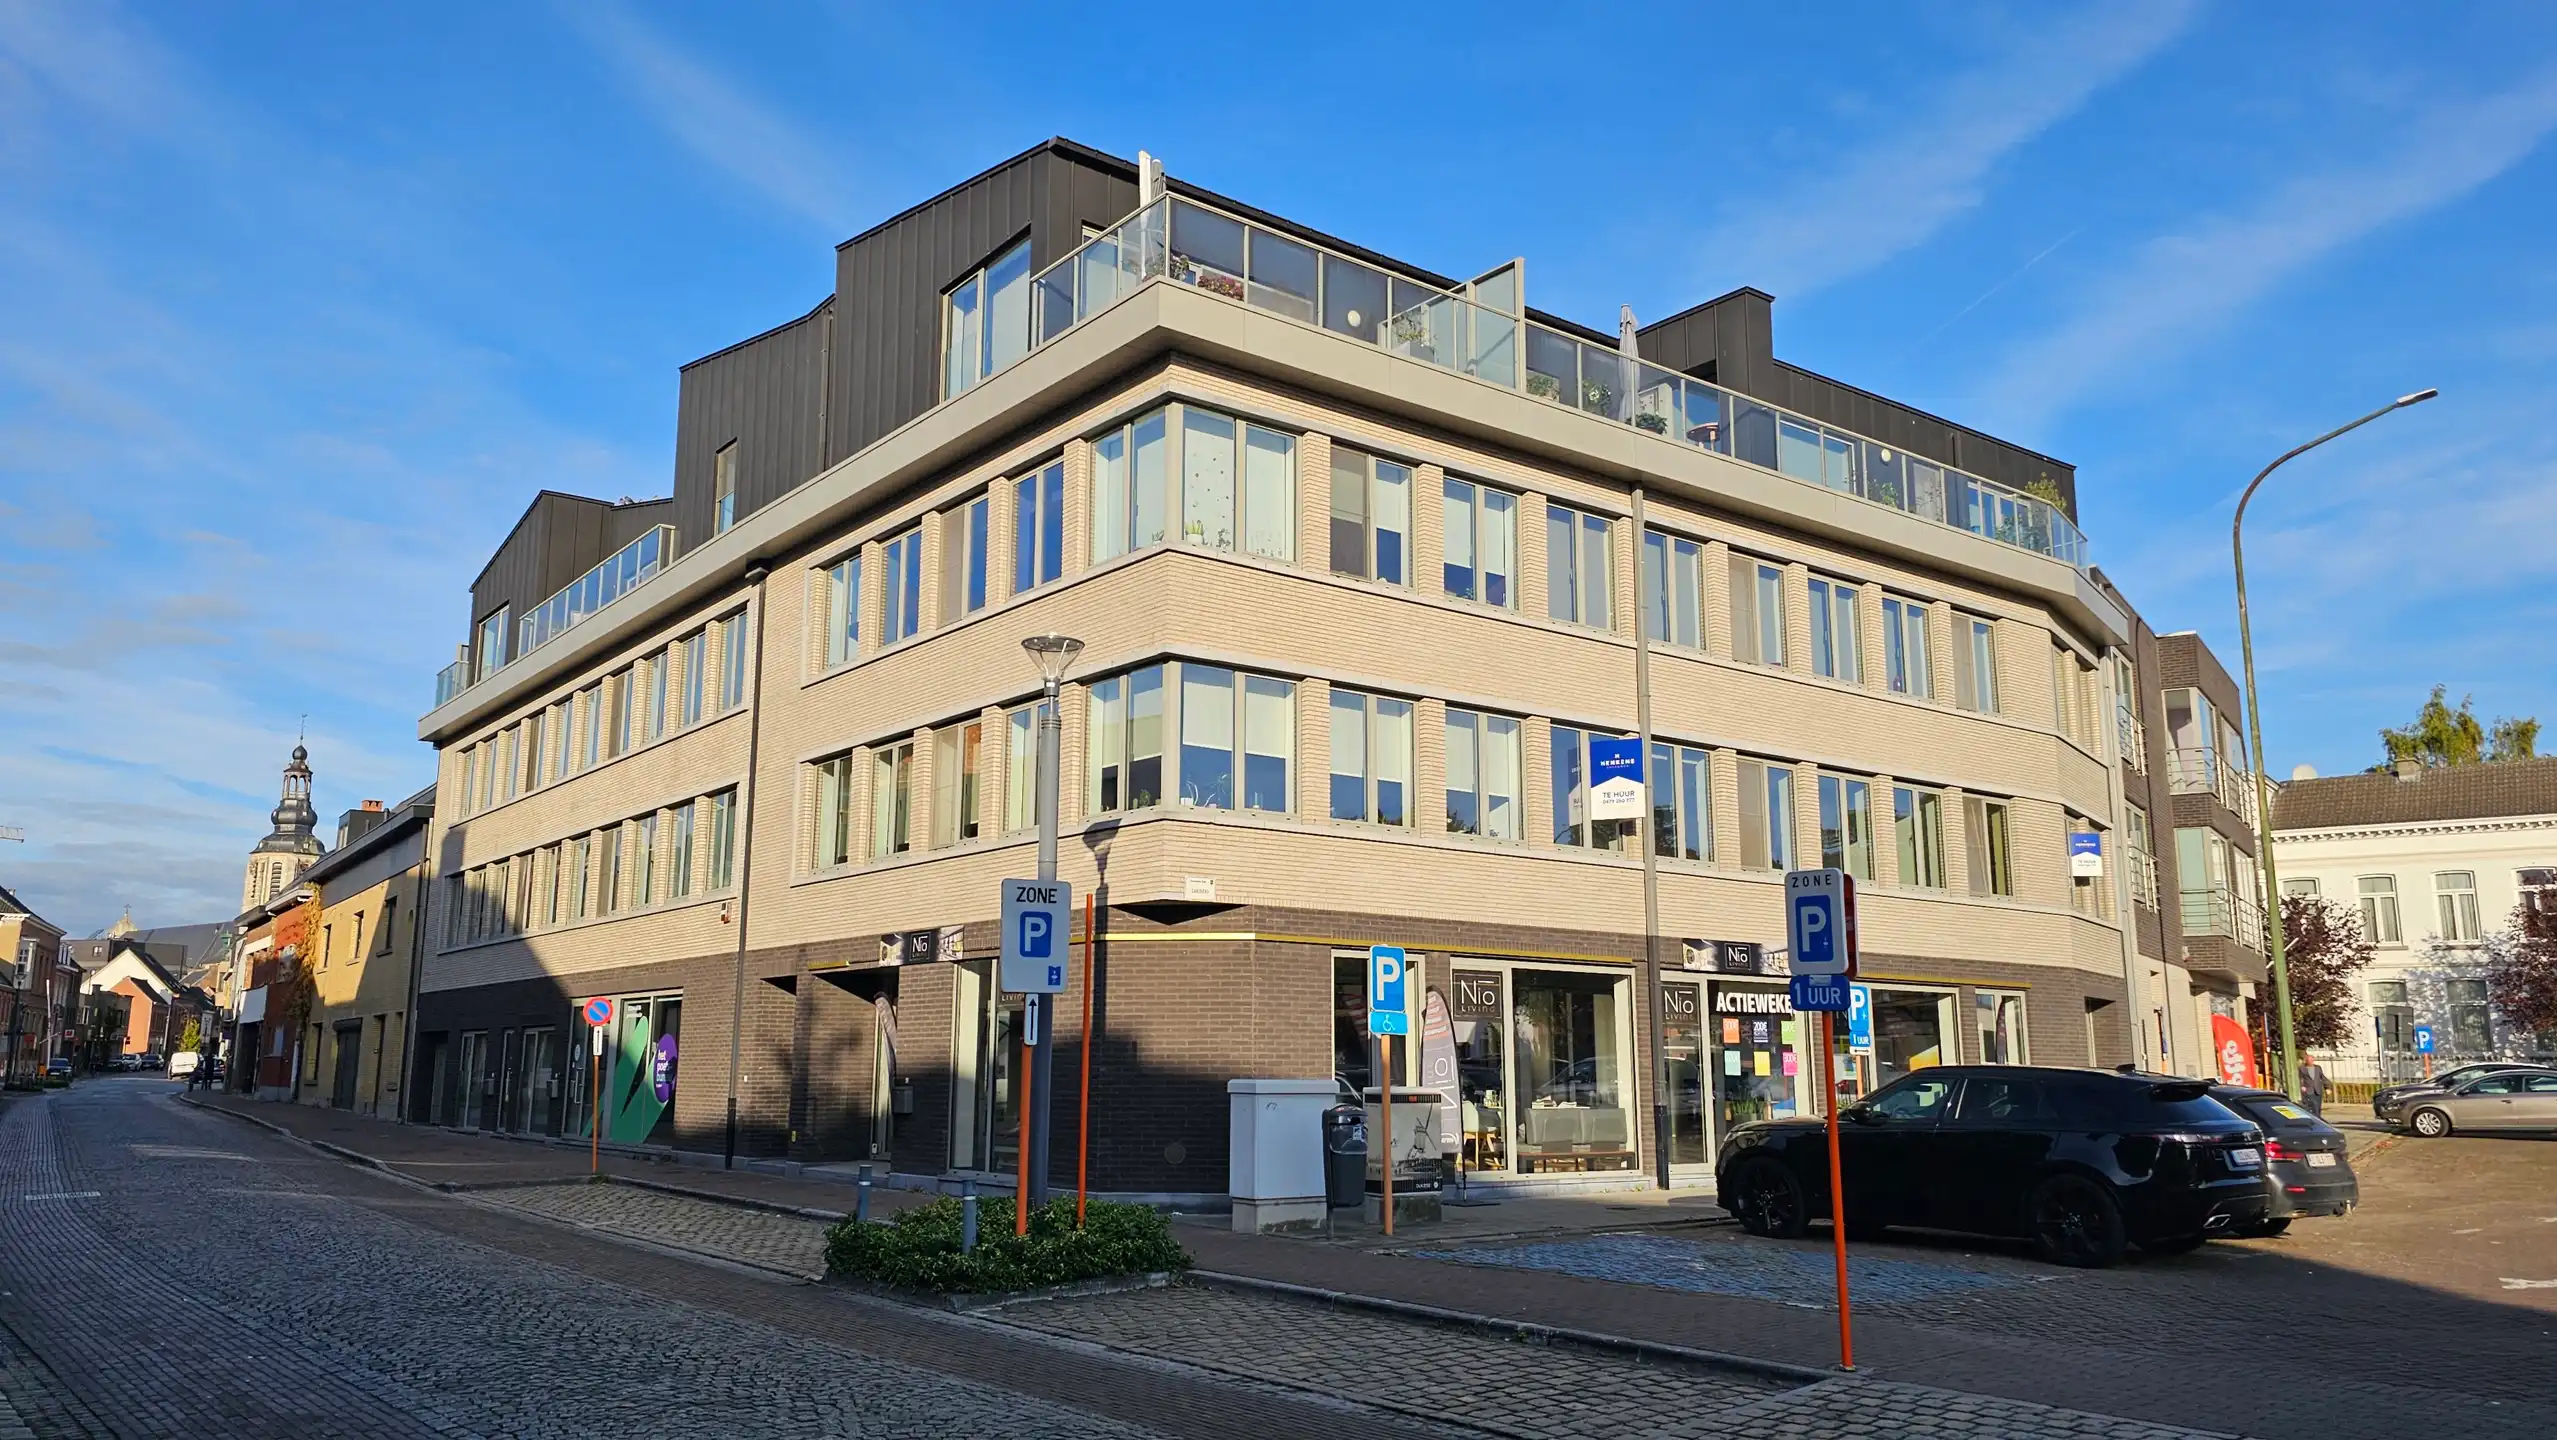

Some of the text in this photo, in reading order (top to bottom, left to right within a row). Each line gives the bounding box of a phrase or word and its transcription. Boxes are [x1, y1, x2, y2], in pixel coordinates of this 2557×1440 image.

[1613, 790, 1635, 798] HUUR
[1791, 874, 1832, 888] ZONE
[1016, 887, 1058, 904] ZONE
[1024, 916, 1047, 952] P
[1800, 905, 1827, 952] P
[1376, 956, 1400, 1001] P
[1461, 980, 1495, 1006] Nio
[1664, 990, 1694, 1014] Nio
[1794, 982, 1842, 1005] 1 UUR
[1850, 989, 1865, 1021] P
[1852, 1033, 1869, 1045] 1 UUR
[2418, 1030, 2430, 1049] P
